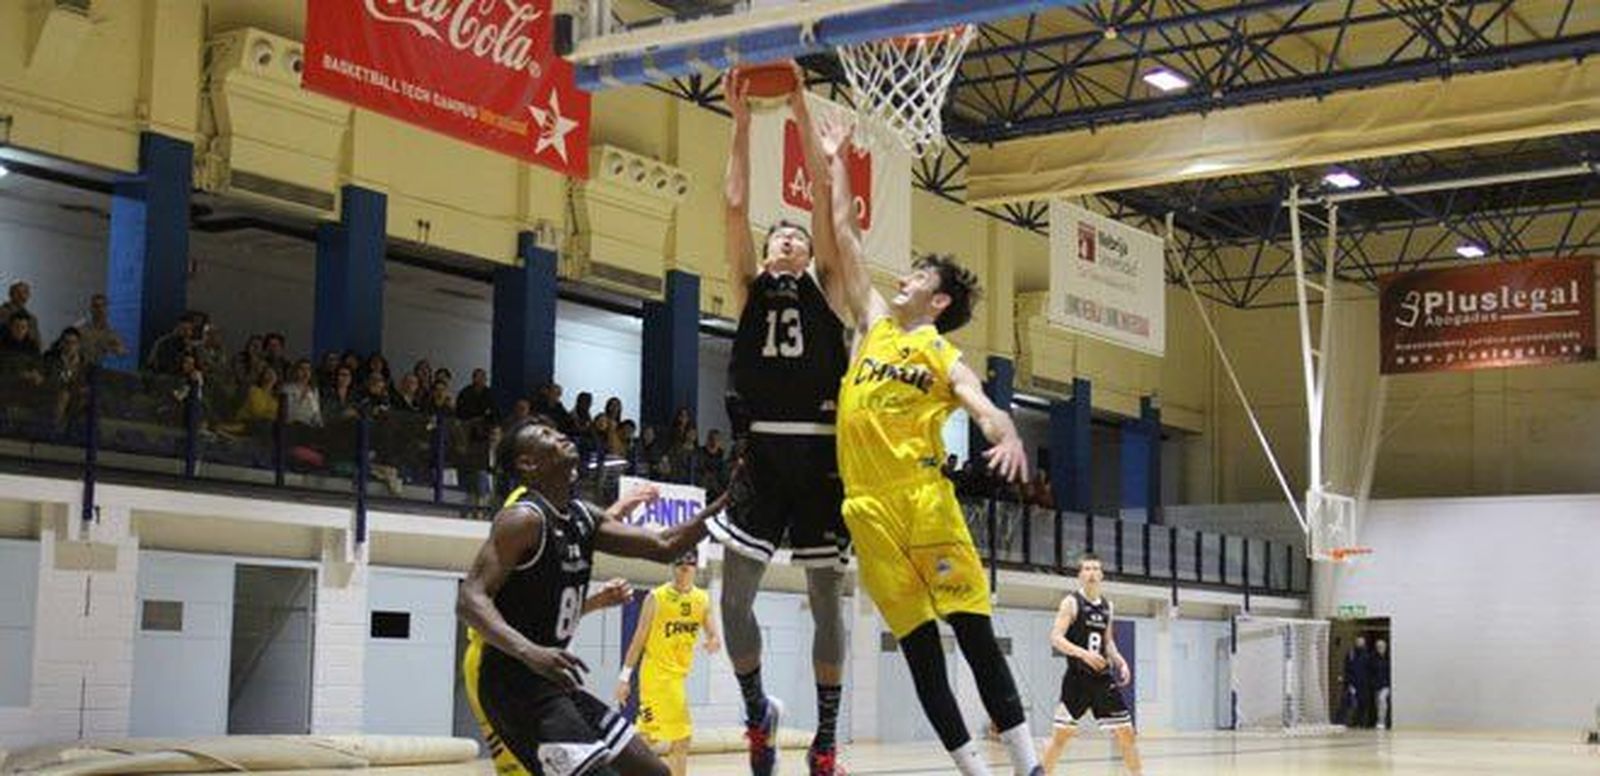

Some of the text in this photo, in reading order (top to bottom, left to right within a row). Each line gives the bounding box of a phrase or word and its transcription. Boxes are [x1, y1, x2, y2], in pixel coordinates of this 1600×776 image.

[322, 54, 401, 93] BASKETBALL
[433, 91, 478, 120] CAMPUS
[1424, 280, 1579, 315] Pluslegal
[762, 308, 804, 358] 13
[1424, 312, 1498, 327] Abogados
[1088, 631, 1102, 656] 8
